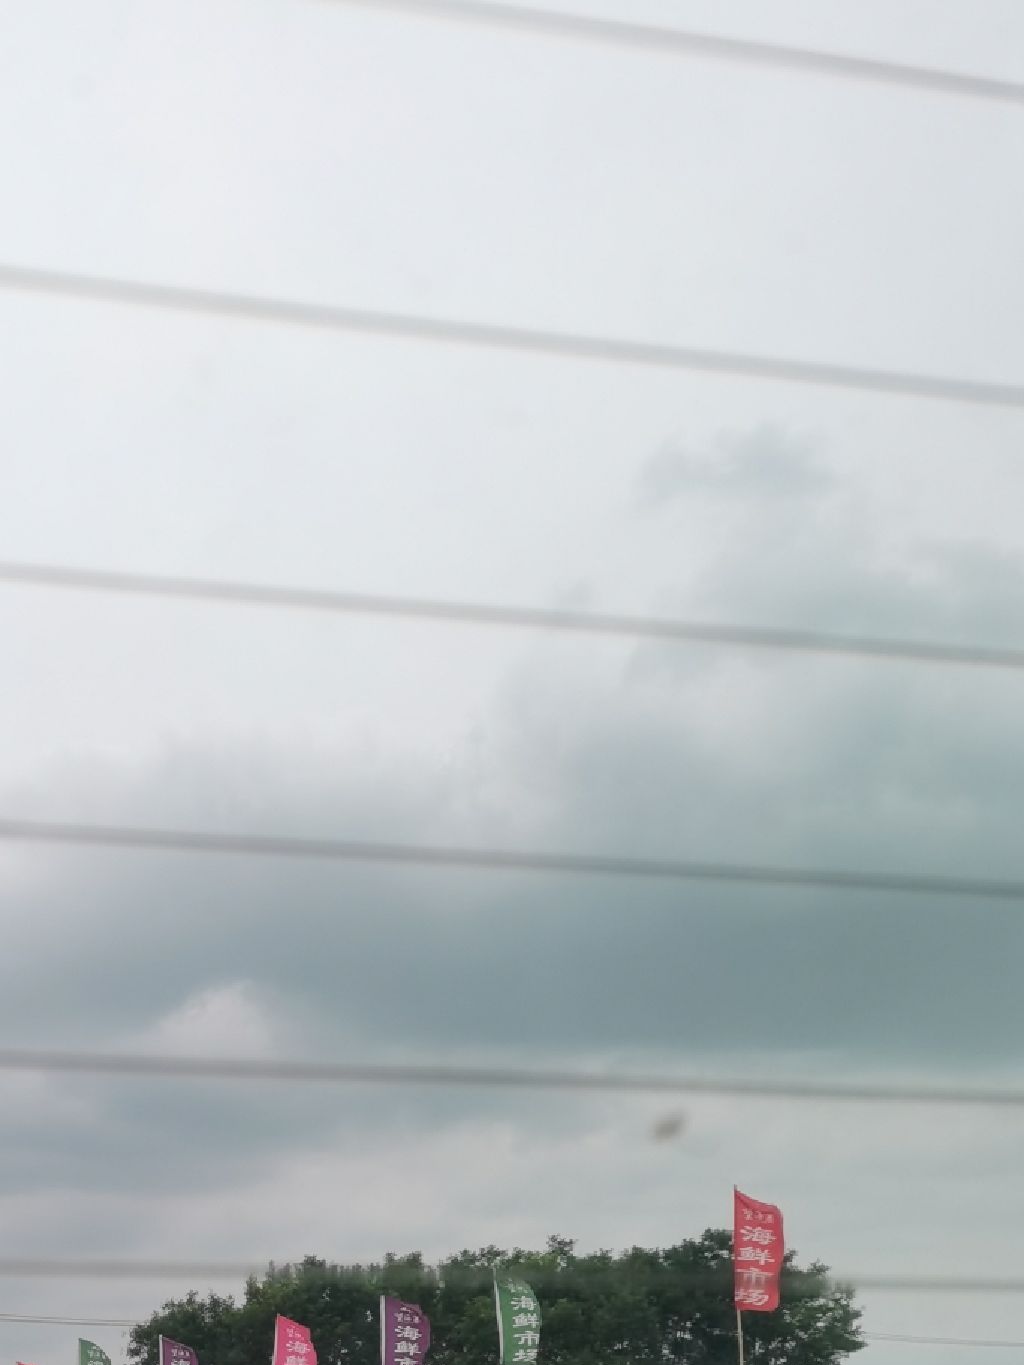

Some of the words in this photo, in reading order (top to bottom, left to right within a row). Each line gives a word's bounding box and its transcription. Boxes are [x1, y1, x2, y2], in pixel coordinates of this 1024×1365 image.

[735, 1225, 776, 1306] 海鲜市场
[511, 1296, 539, 1365] 海鲜市场
